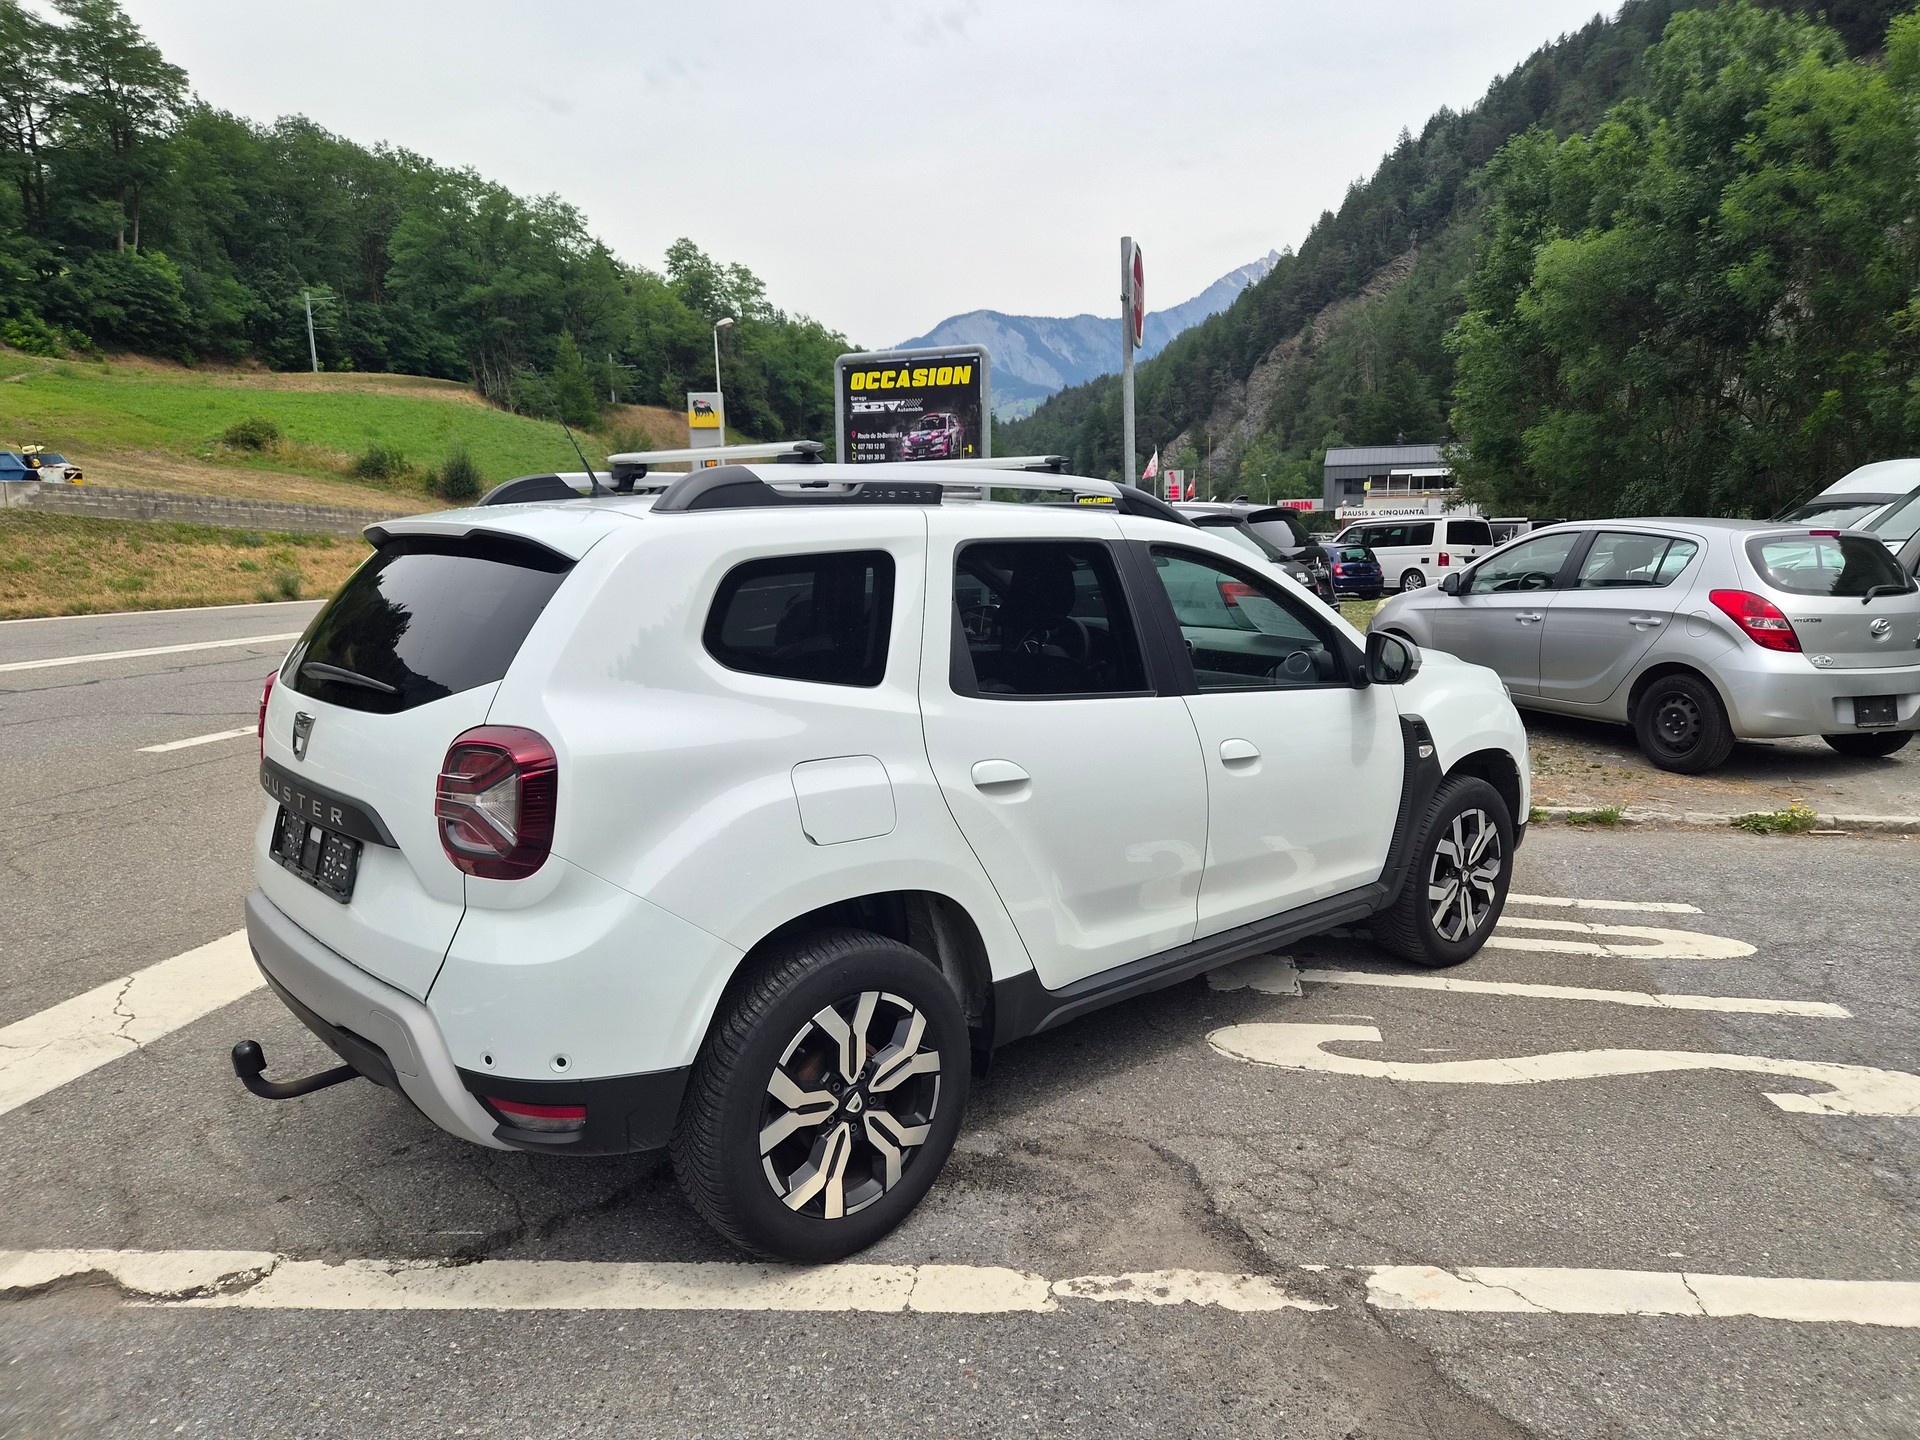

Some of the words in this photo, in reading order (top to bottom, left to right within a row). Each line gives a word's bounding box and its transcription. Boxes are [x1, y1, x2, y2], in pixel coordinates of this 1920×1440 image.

[850, 365, 972, 391] OCCASION
[862, 490, 933, 498] DUSTER
[1379, 508, 1425, 516] CINQUANTA
[264, 771, 344, 827] DUSTER
